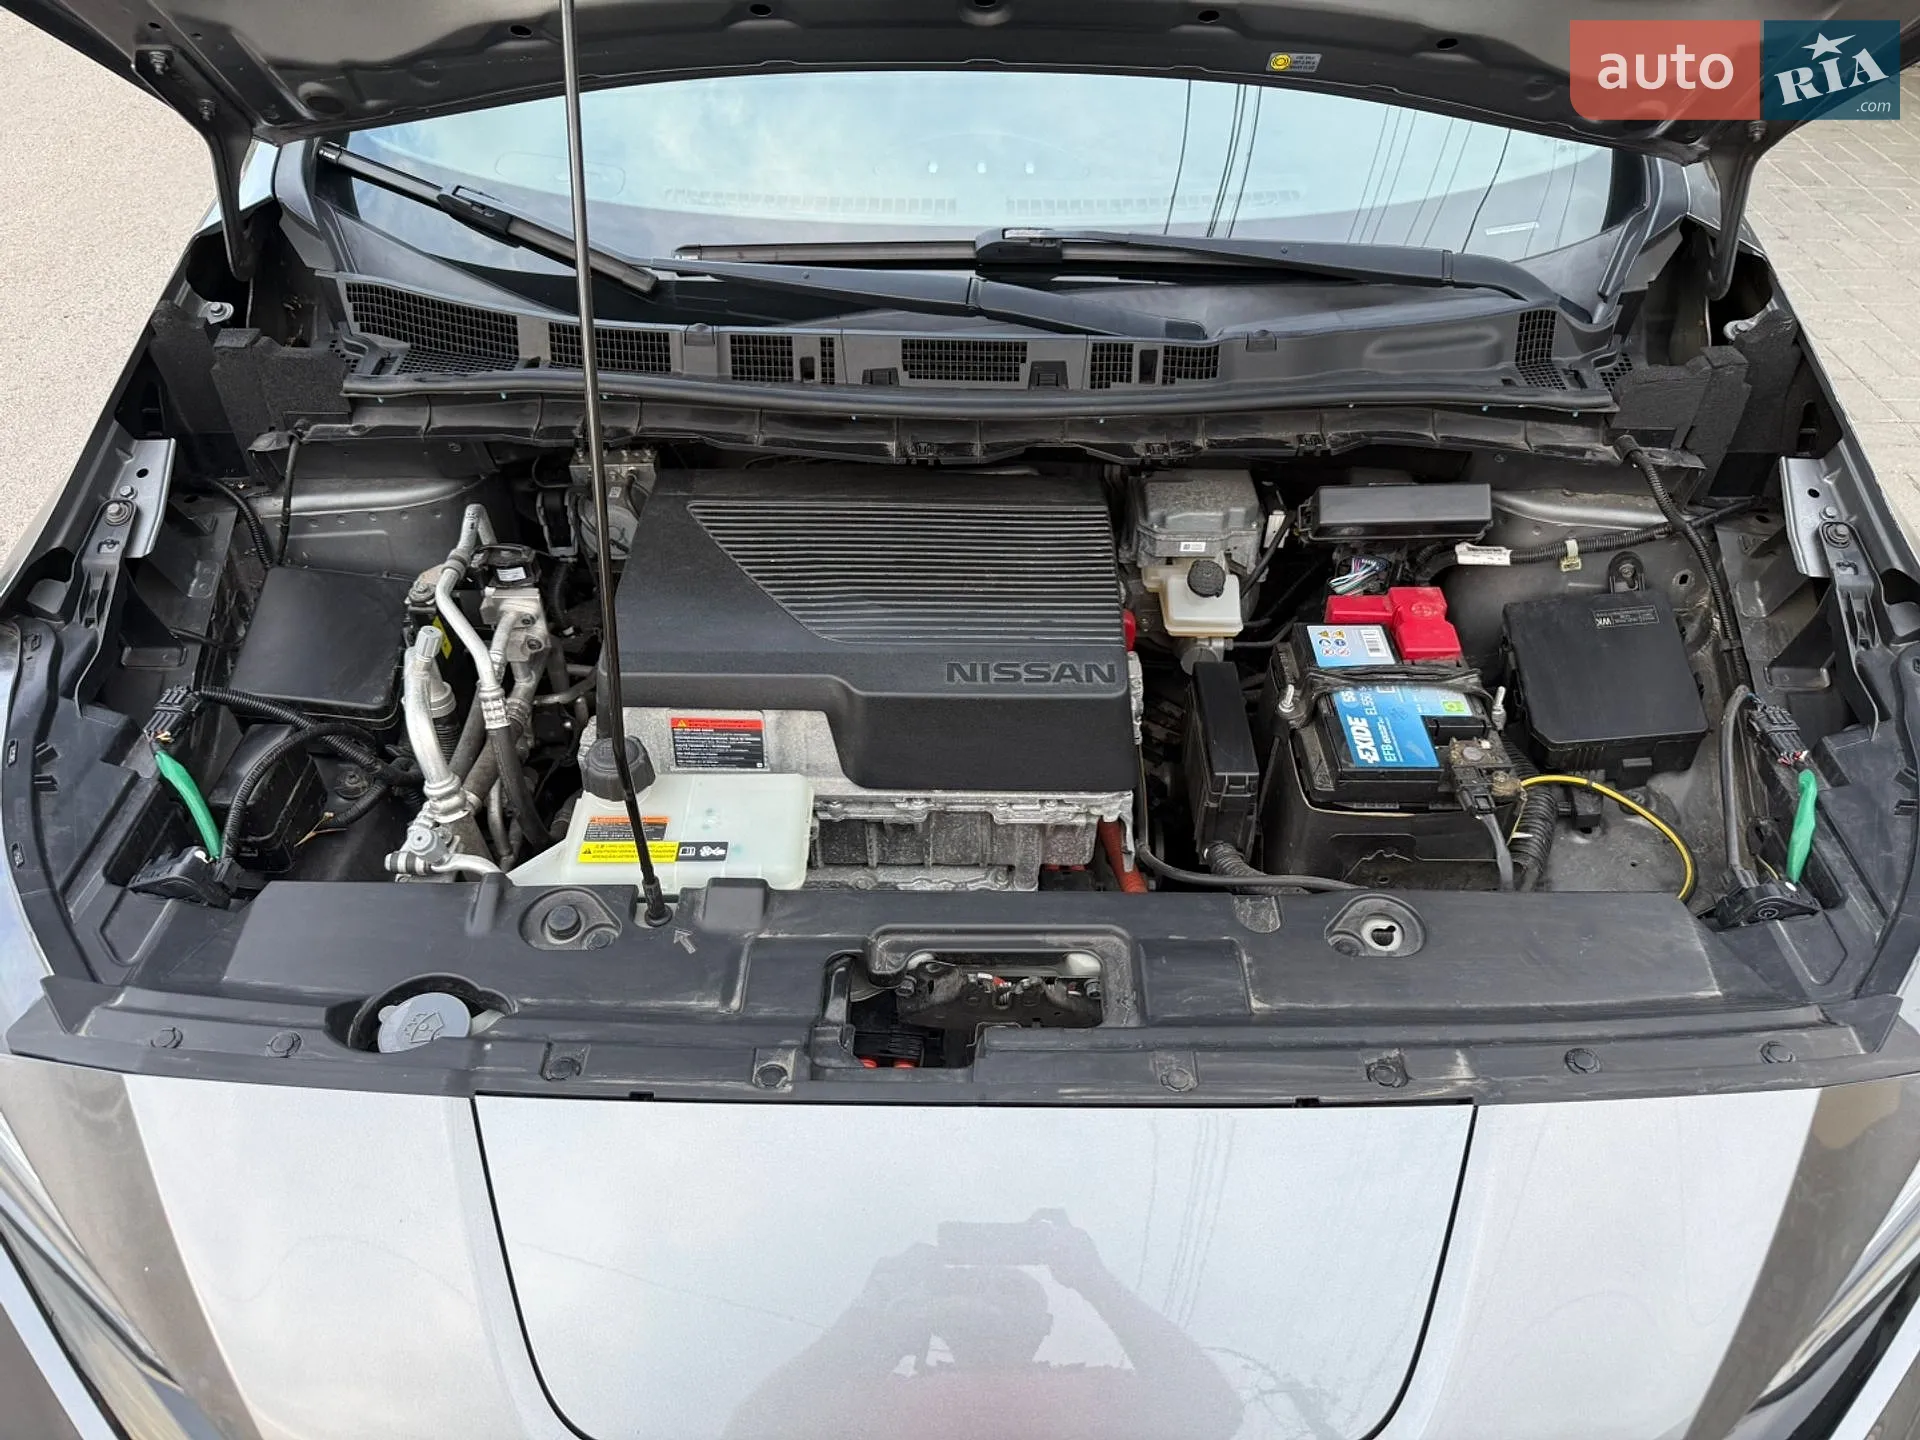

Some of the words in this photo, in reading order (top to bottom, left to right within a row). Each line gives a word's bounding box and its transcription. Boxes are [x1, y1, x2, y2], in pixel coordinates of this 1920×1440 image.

[946, 662, 1116, 684] NISSAN
[1347, 714, 1381, 764] EXIDE
[1380, 743, 1397, 763] EFB
